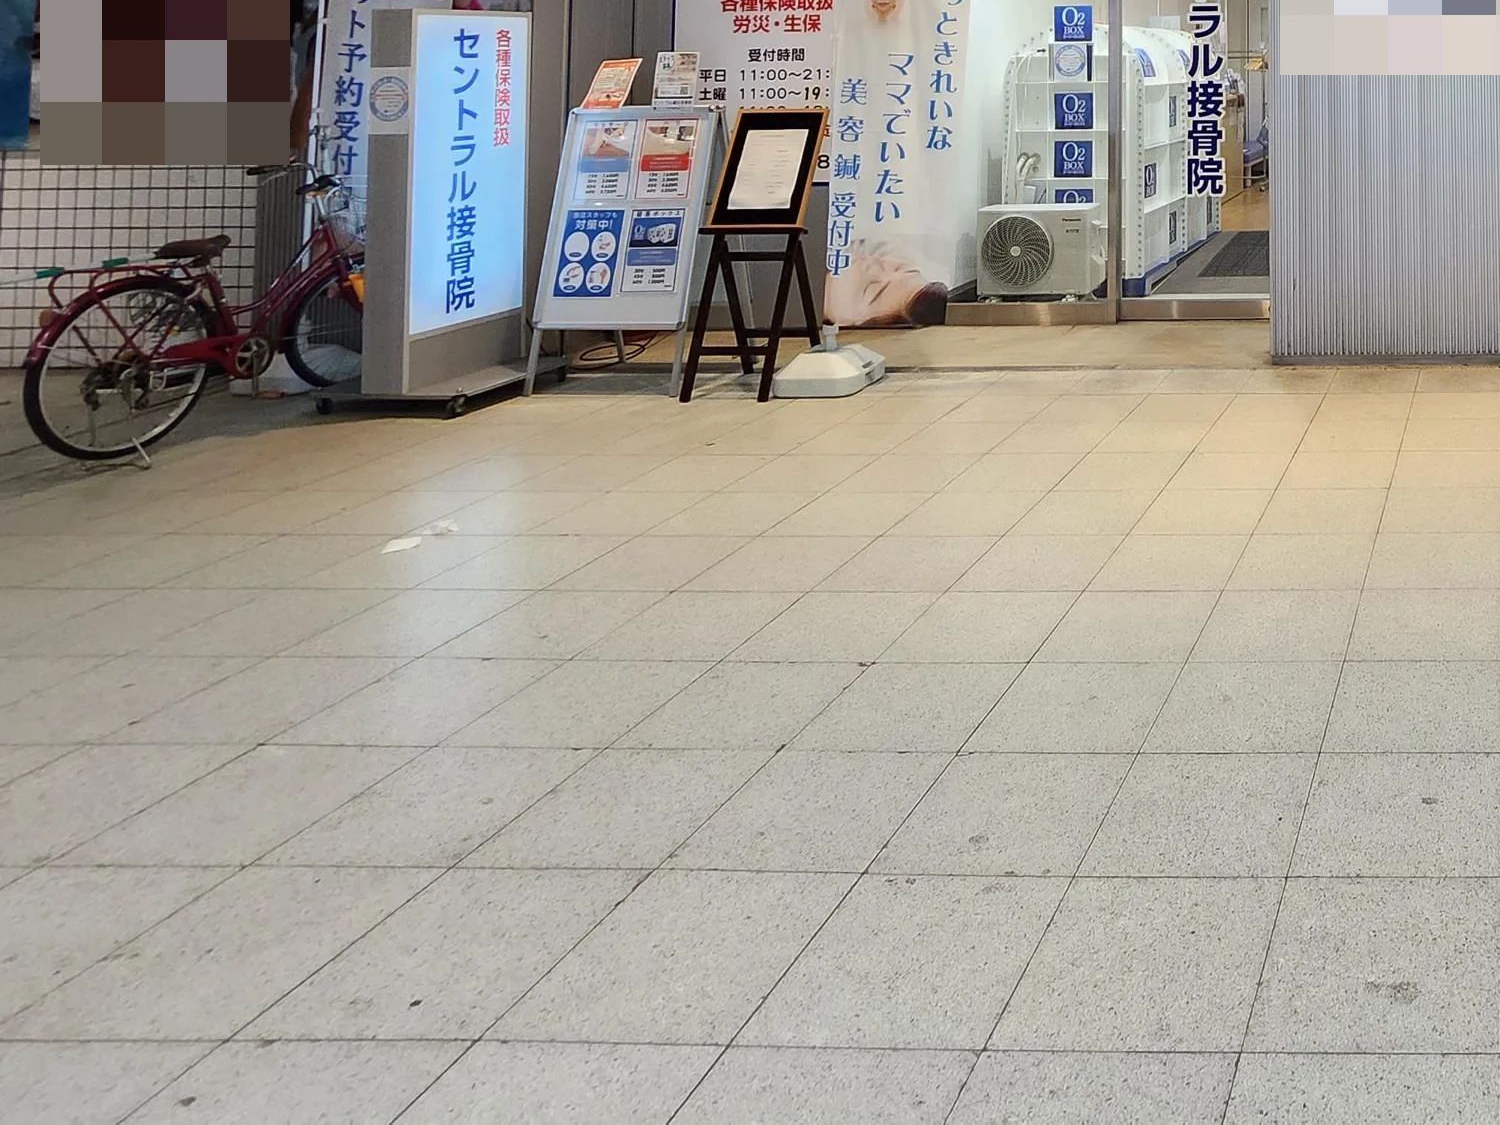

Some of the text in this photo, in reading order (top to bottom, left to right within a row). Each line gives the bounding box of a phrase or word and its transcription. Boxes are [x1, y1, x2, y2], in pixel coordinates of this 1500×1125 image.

[733, 15, 821, 34] 労災・生保
[1063, 27, 1084, 35] BOX
[748, 48, 805, 62] 受付時間
[699, 69, 726, 83] 平日
[493, 29, 512, 147] 各種保険取扱
[699, 88, 727, 101] 土曜
[1064, 114, 1085, 122] BOX
[875, 52, 914, 223] ママでいたい
[446, 28, 480, 314] セントラル接骨院
[1063, 162, 1084, 170] BOX
